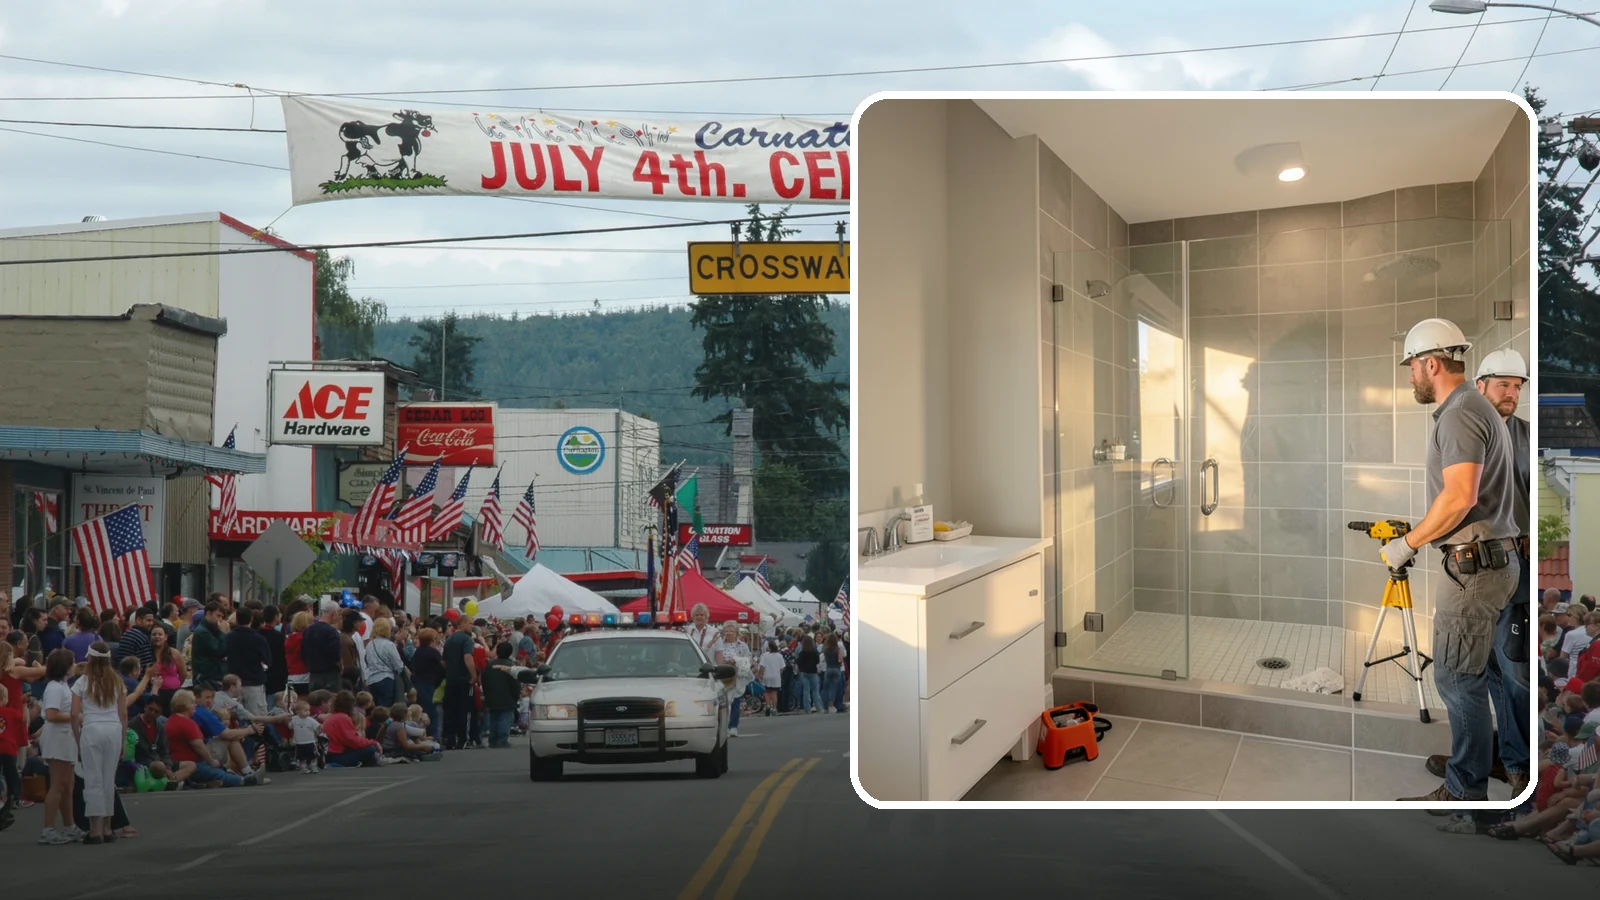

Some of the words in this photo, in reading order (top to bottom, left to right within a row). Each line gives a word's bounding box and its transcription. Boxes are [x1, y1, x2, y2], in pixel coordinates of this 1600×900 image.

[695, 121, 850, 149] Carnat
[481, 141, 605, 192] JULY
[632, 150, 746, 197] 4th.
[697, 254, 850, 280] CROSSWA
[283, 380, 373, 419] ACE
[406, 409, 452, 422] CEDAR
[283, 421, 371, 436] Hardware
[83, 485, 93, 494] St.
[96, 485, 124, 495] Vincent
[126, 485, 135, 495] de
[138, 487, 155, 495] Paul
[688, 526, 741, 535] CRNATION
[699, 535, 730, 543] GLASS
